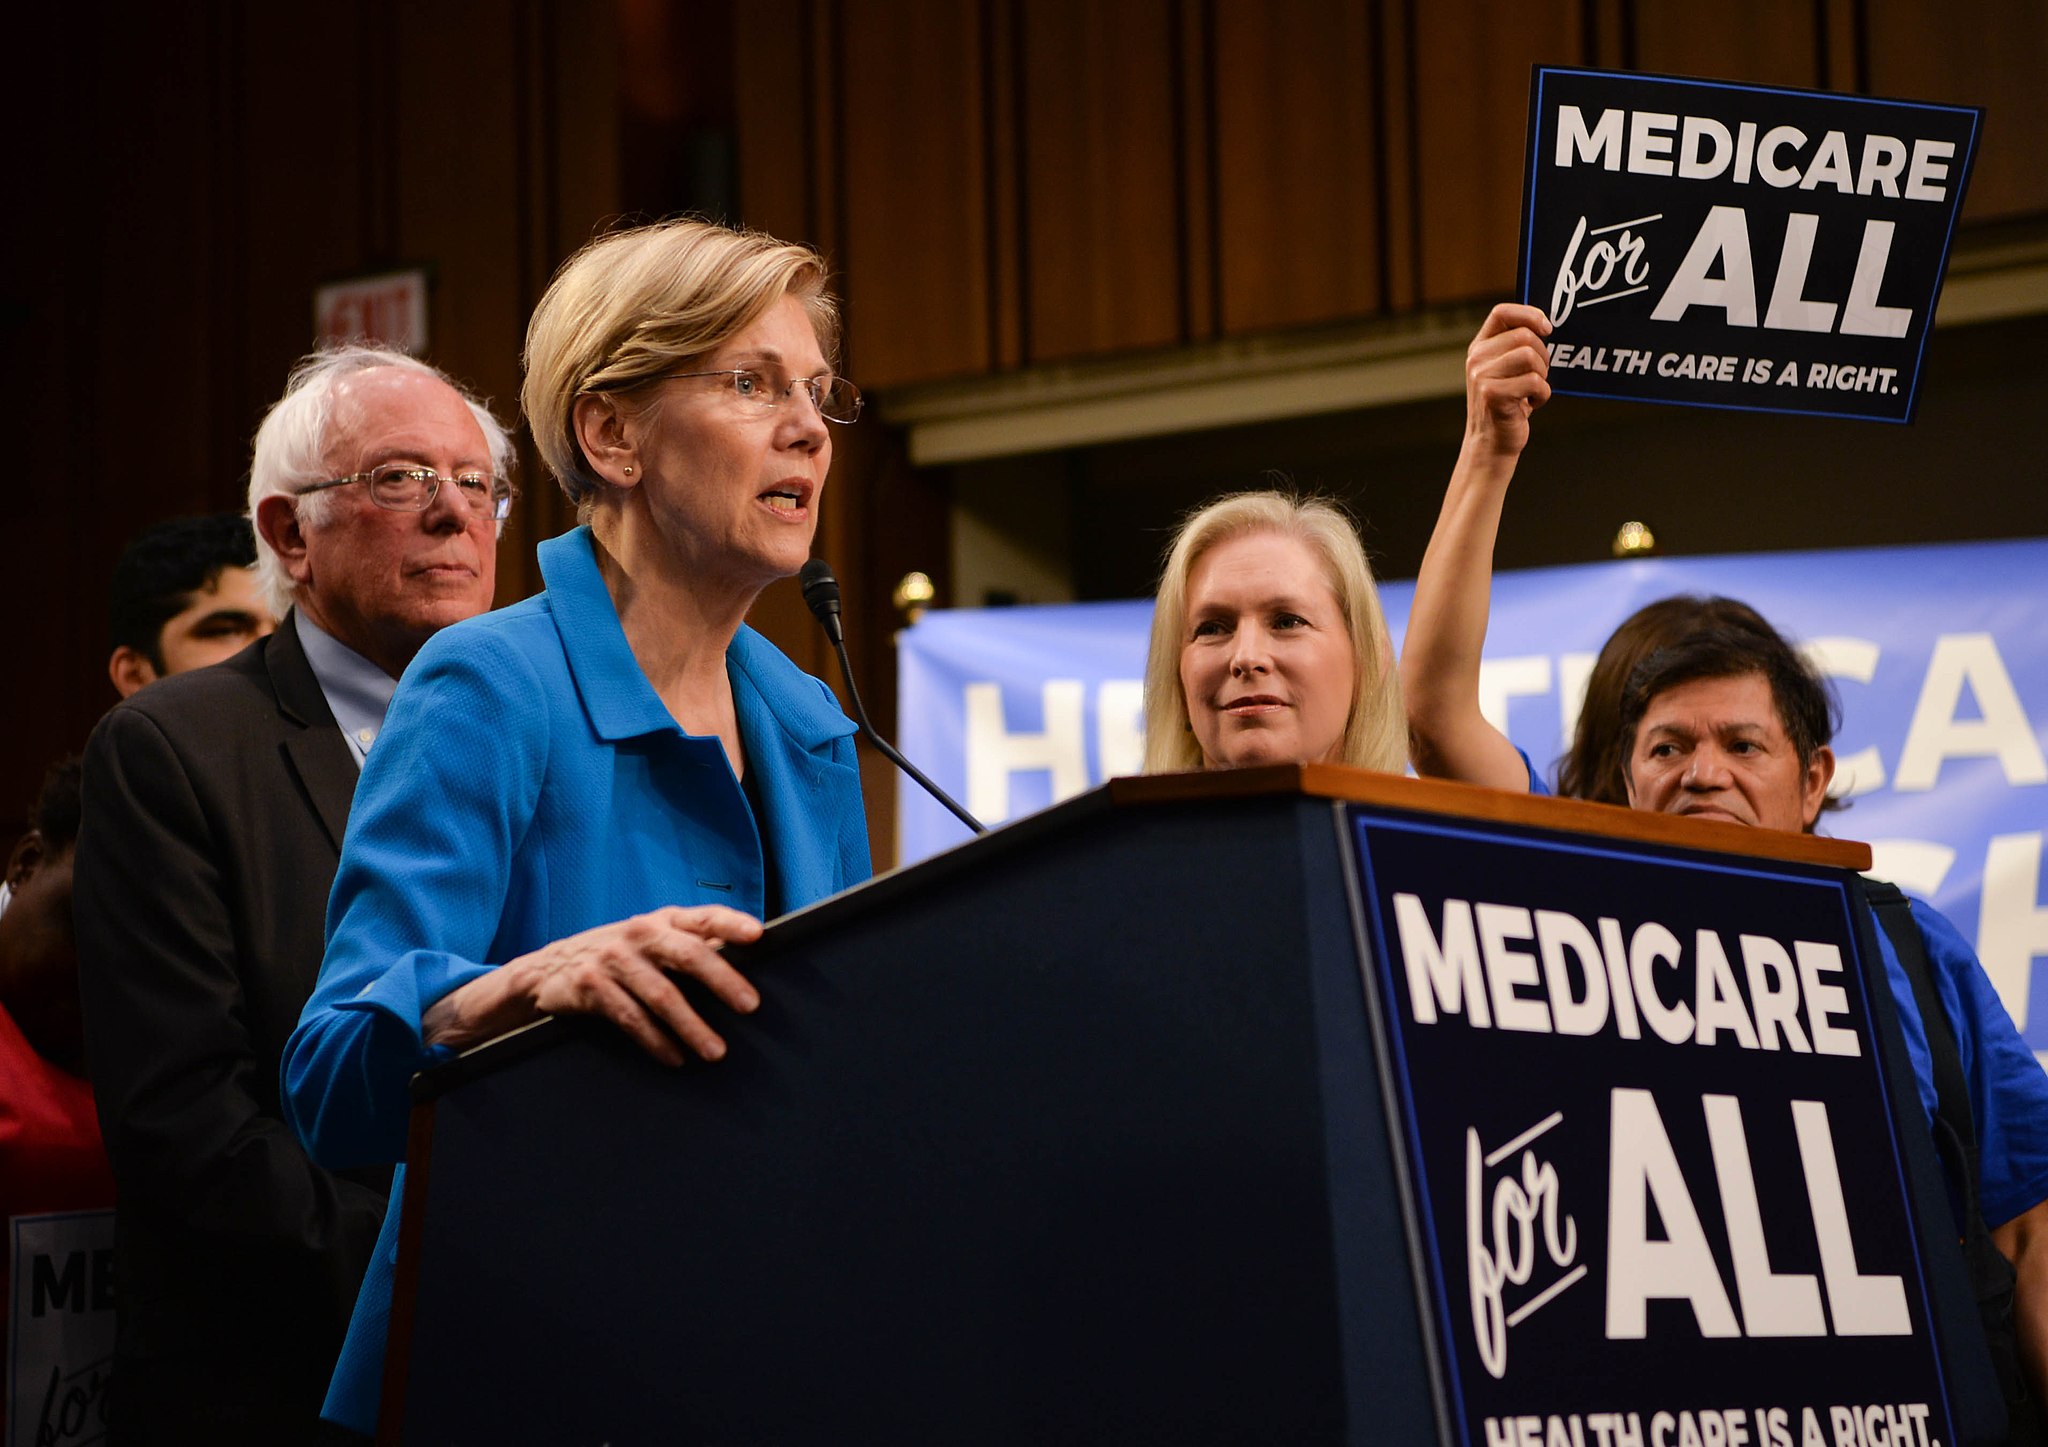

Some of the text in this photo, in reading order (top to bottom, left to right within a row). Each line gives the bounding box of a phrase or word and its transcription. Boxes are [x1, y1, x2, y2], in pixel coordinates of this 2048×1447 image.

[1555, 105, 1955, 202] MEDICARE
[1550, 205, 1913, 339] for ALL
[1657, 353, 1739, 382] CARE
[1742, 358, 1774, 384] IS
[1775, 361, 1799, 387] A
[1806, 363, 1899, 395] RIGHT.
[1393, 893, 1862, 1057] MEDICARE
[1465, 1088, 1913, 1379] for ALL
